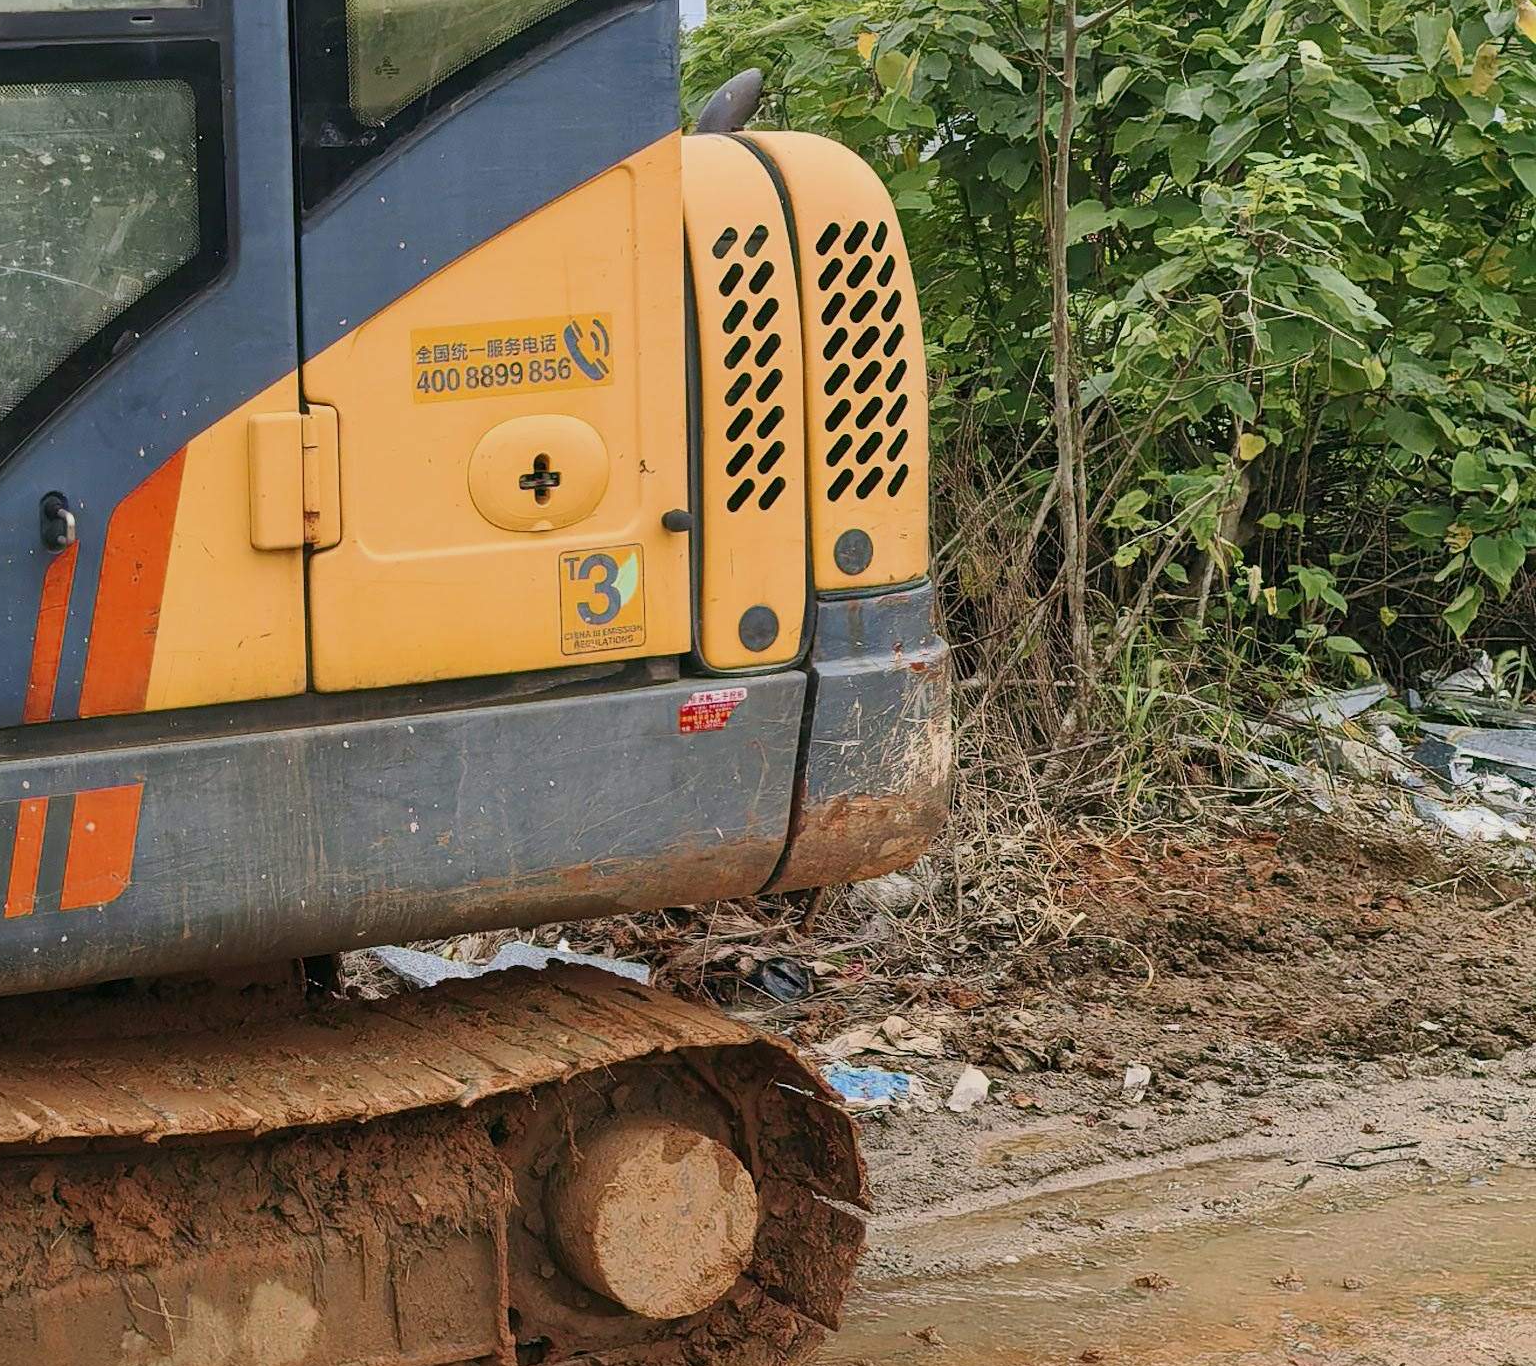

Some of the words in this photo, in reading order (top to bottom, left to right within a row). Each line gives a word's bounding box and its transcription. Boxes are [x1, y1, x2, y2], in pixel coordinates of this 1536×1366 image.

[416, 334, 557, 365] 全国统一服务电话
[416, 367, 461, 394] 400
[465, 362, 524, 390] 8899
[528, 356, 571, 384] 856
